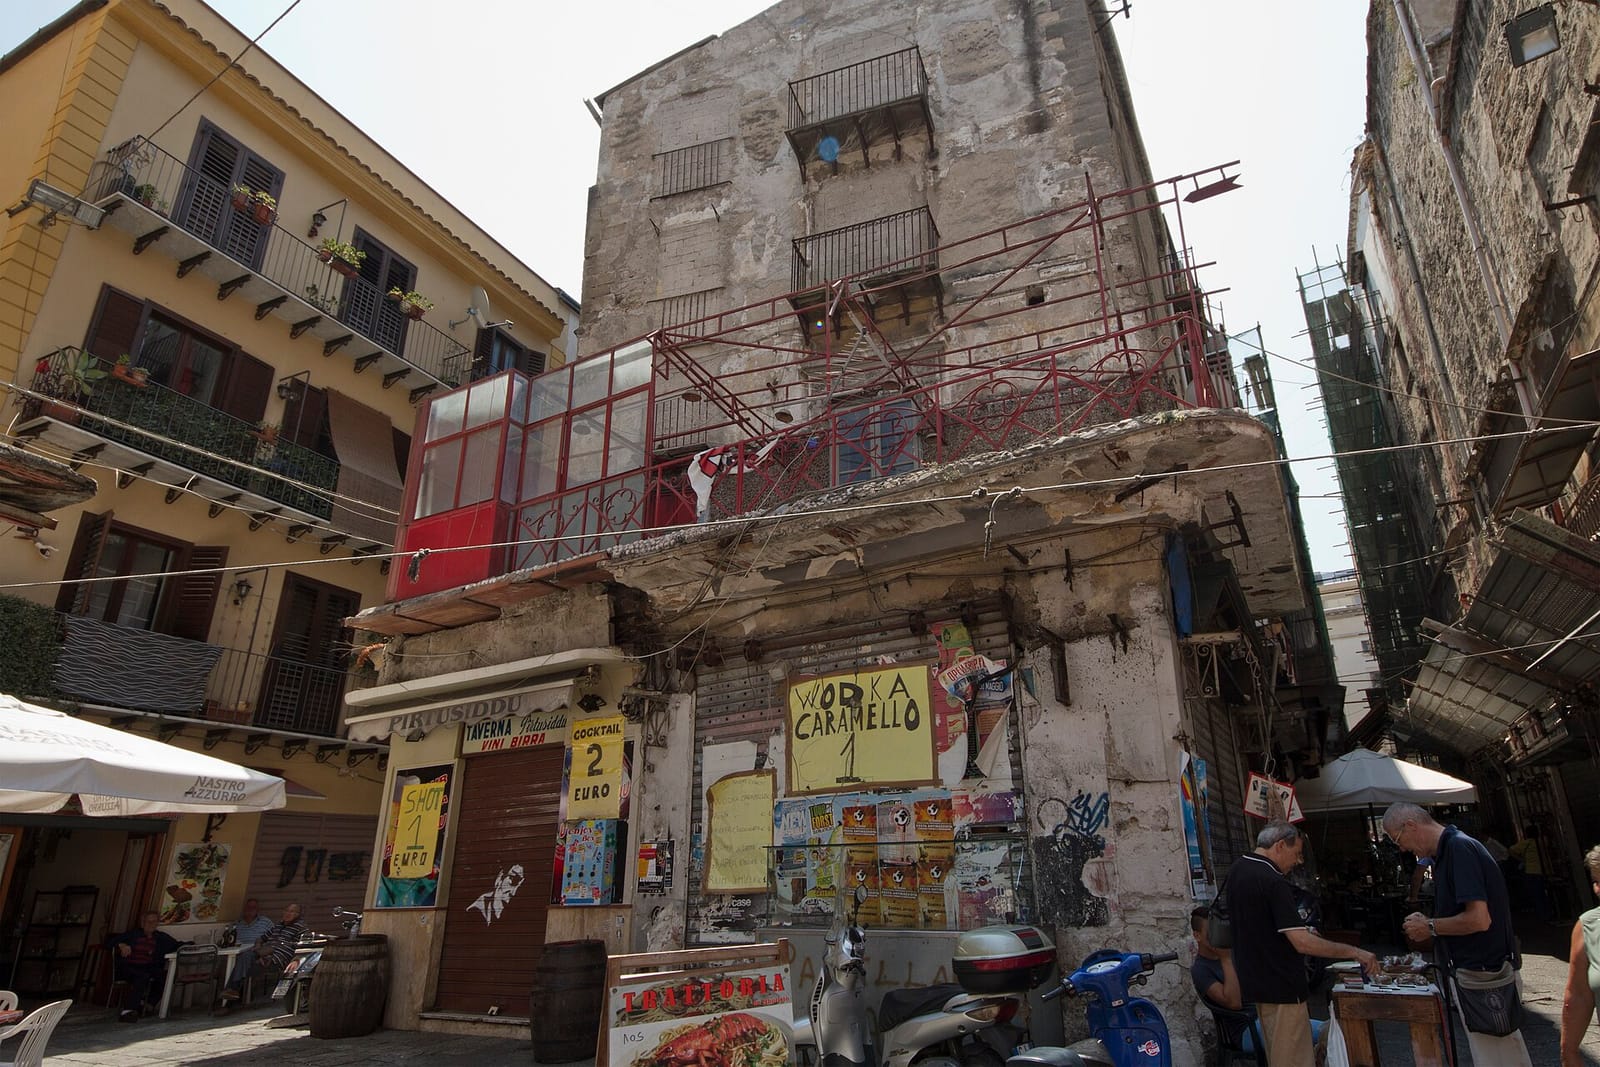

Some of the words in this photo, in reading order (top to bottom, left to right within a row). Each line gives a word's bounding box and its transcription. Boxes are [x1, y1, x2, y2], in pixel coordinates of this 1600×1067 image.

[795, 672, 910, 710] WODKA
[388, 696, 521, 731] PIRTUSIDDU
[795, 699, 920, 740] CARAMELLO
[466, 719, 512, 741] TAVERNA
[573, 724, 621, 740] COCKTAIL
[481, 737, 503, 751] VINI
[510, 732, 546, 748] BIRRA
[586, 743, 604, 777] 2
[184, 786, 246, 802] AZZURRO
[195, 776, 246, 791] NASTRO
[574, 783, 610, 801] EURO
[405, 787, 443, 814] SHOT
[812, 813, 834, 829] FORST
[406, 815, 424, 850] 1
[393, 852, 428, 867] EURO
[623, 973, 784, 1013] TRATTORIA
